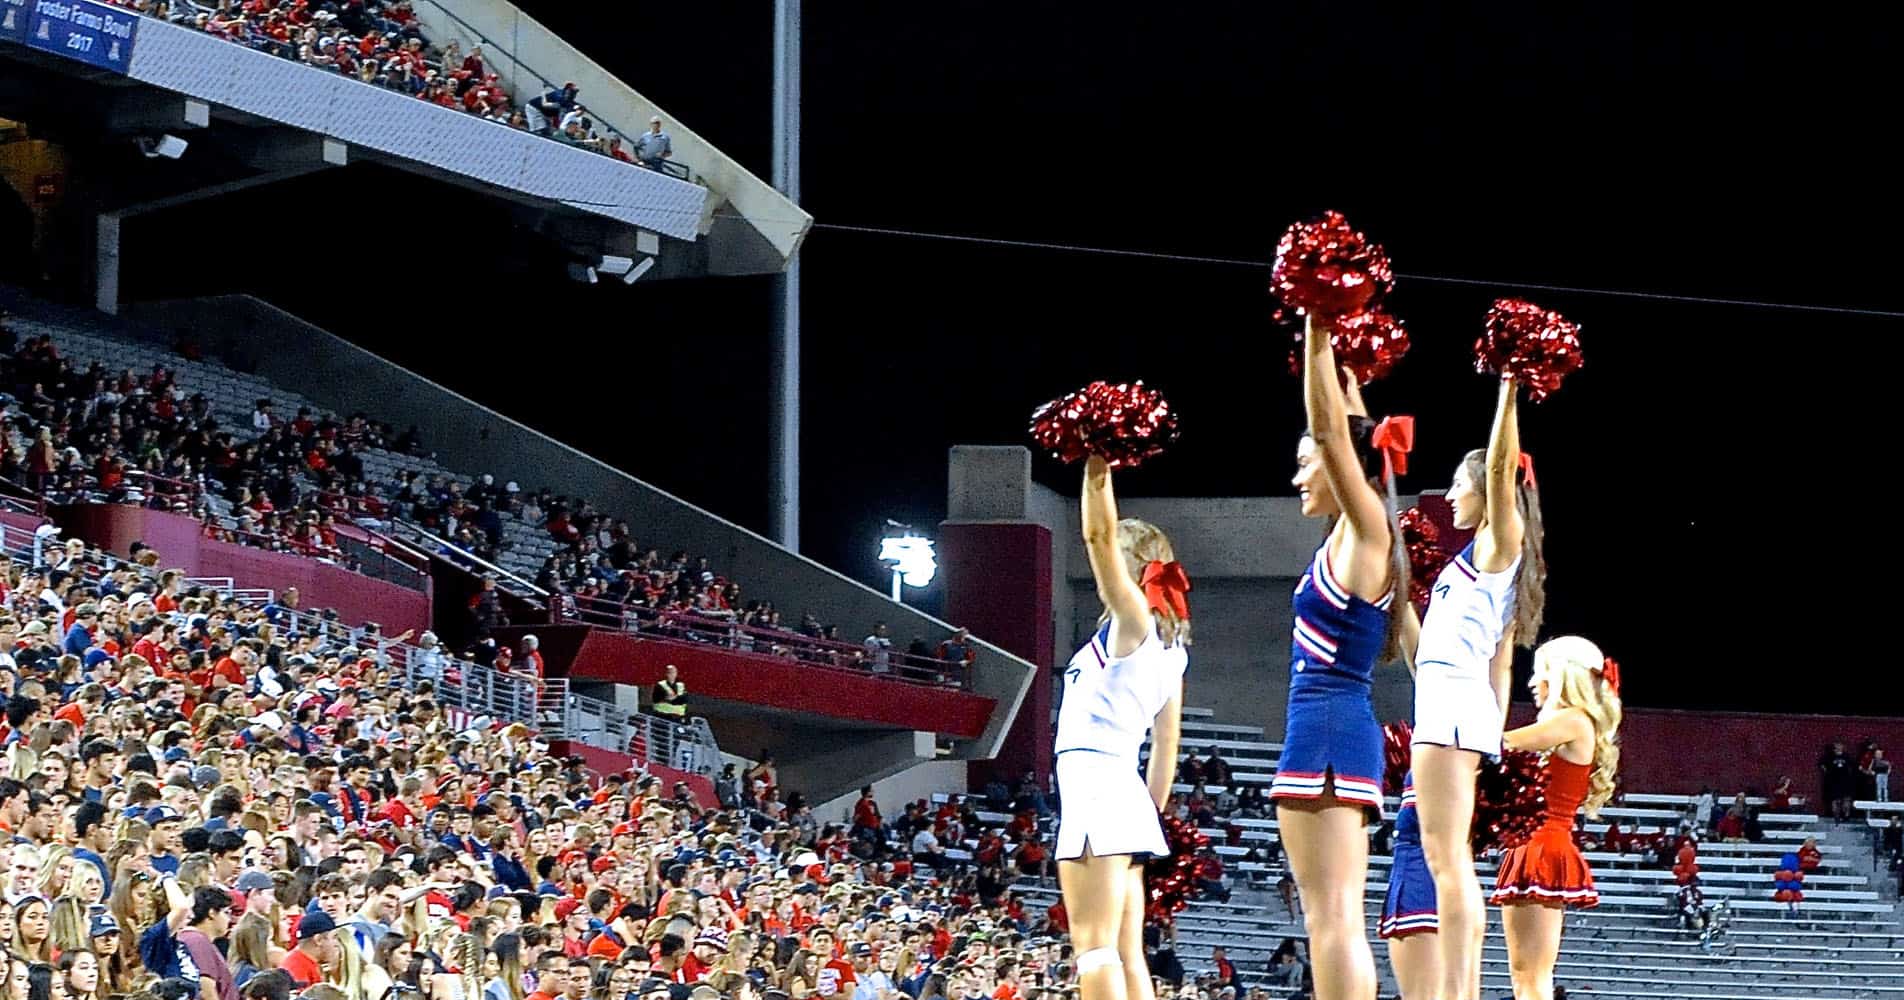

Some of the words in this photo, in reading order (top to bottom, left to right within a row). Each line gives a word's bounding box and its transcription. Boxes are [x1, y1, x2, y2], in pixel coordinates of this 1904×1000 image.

[36, 0, 70, 22] Foster
[70, 5, 103, 31] Farms
[103, 15, 132, 39] Bowl
[67, 32, 93, 51] 2017
